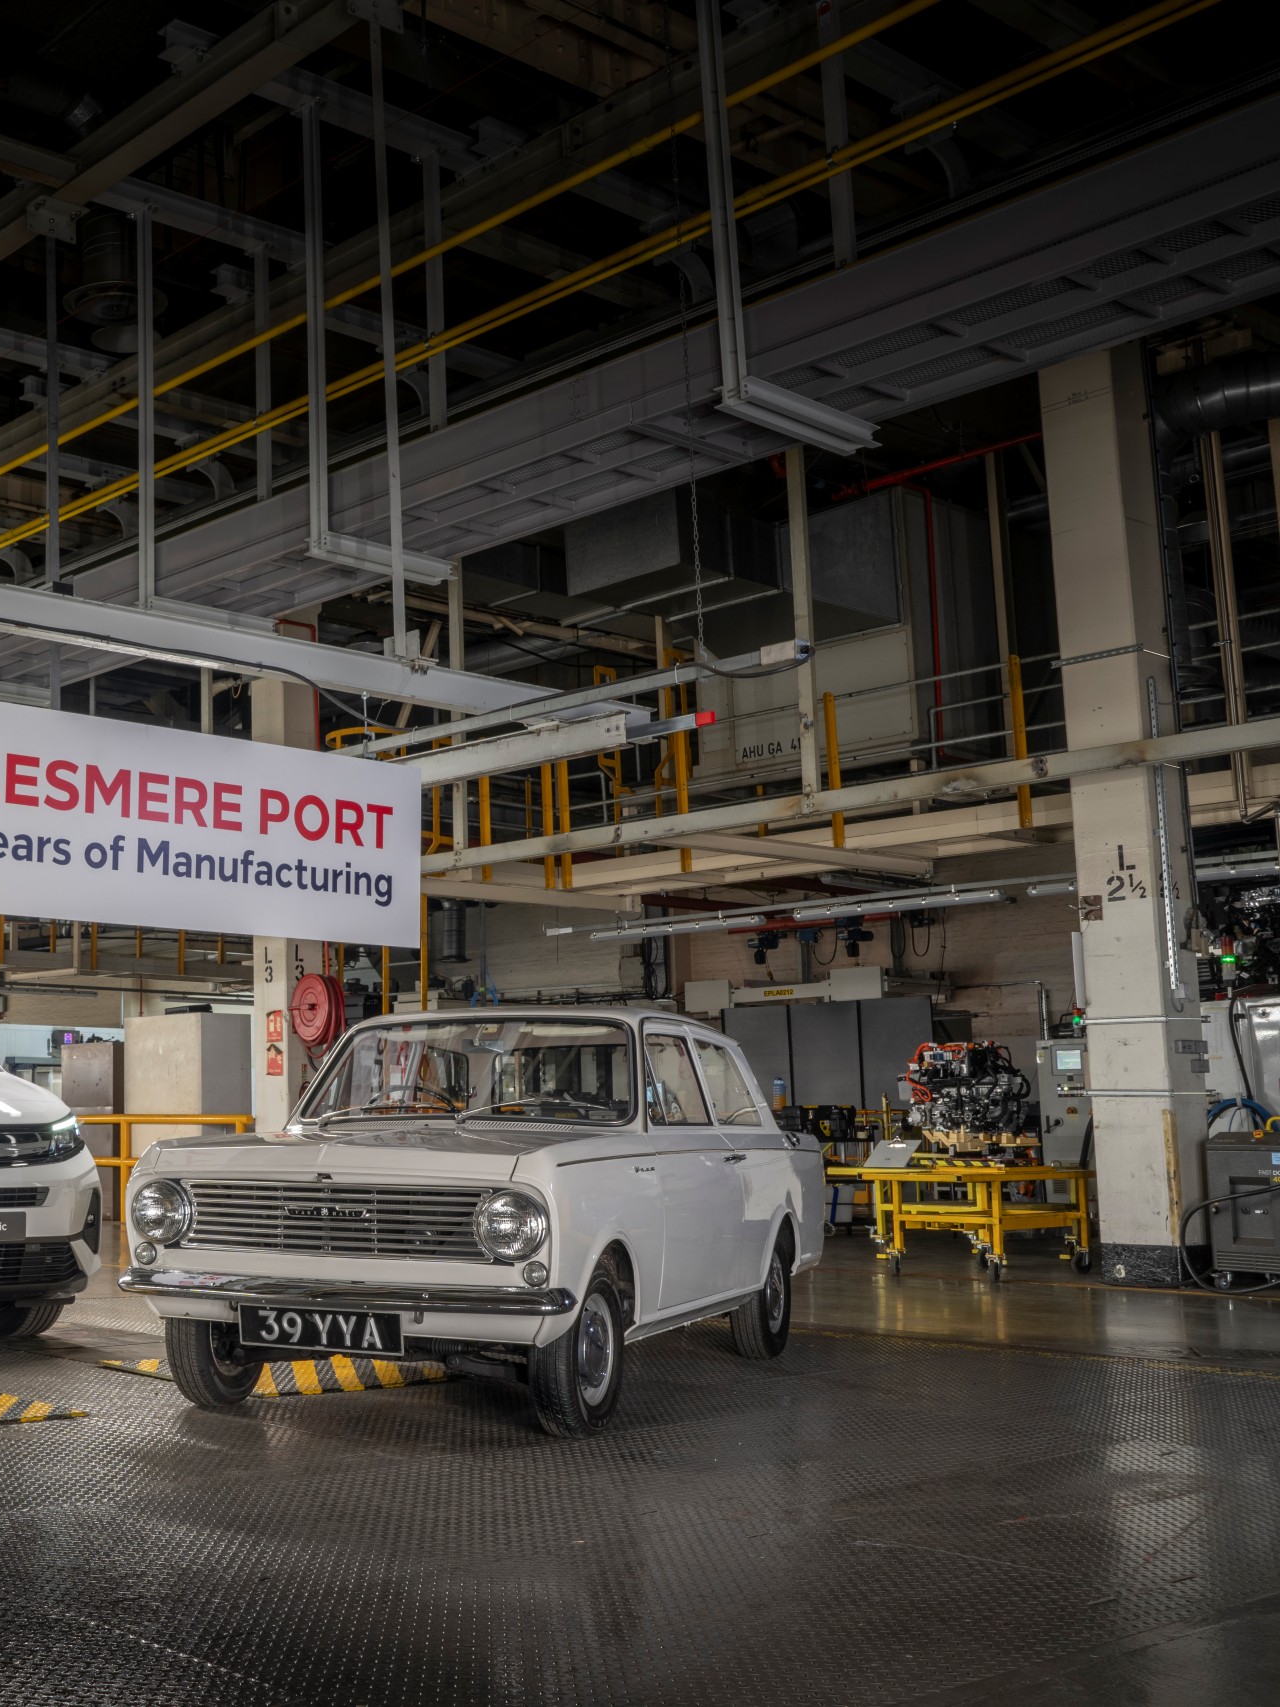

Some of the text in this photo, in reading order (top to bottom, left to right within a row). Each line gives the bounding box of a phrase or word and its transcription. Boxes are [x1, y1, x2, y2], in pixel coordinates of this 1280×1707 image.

[742, 744, 763, 759] AHU
[768, 741, 783, 754] GA
[260, 789, 393, 849] PORT
[1118, 845, 1136, 871] L
[85, 835, 125, 870] of
[137, 838, 393, 907] Manufacturing
[265, 946, 273, 964] L
[295, 944, 304, 962] L
[265, 966, 273, 984] 3
[258, 1310, 383, 1350] 39 YYA
